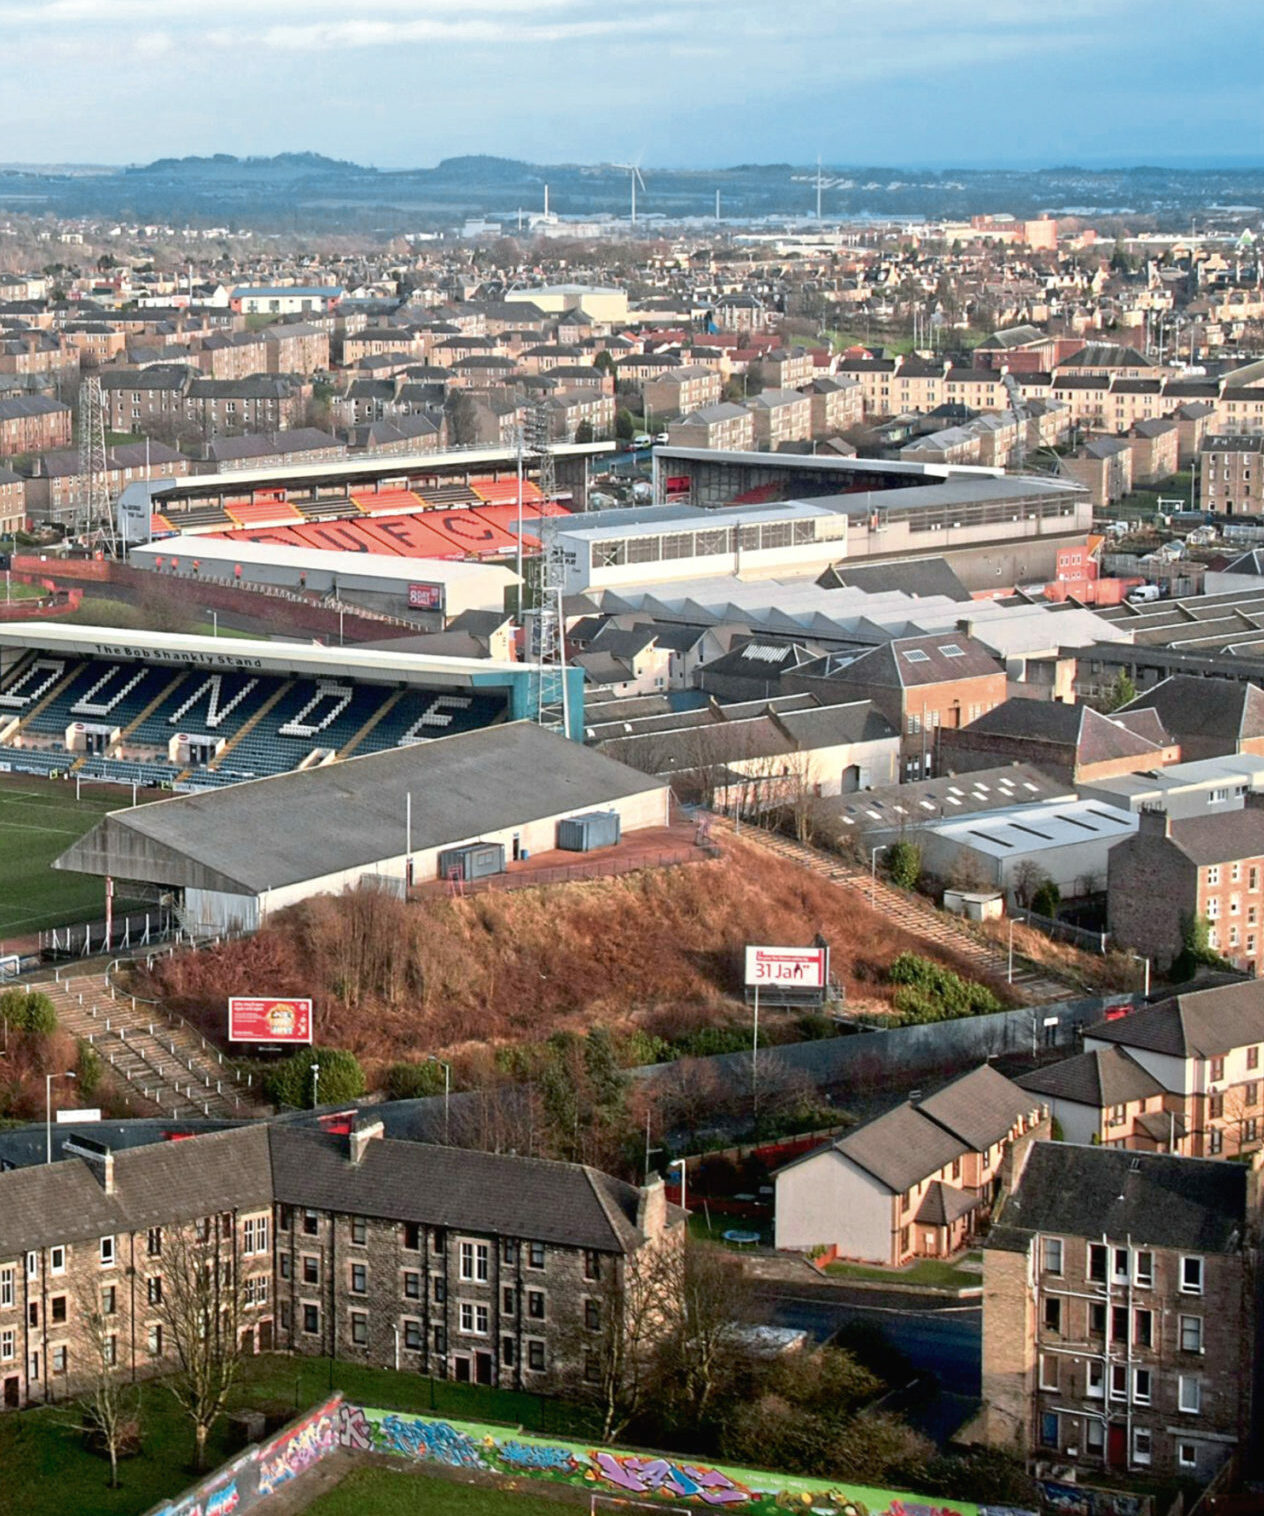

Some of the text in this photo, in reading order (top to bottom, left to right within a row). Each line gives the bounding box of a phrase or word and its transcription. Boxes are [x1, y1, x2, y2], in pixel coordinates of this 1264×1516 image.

[95, 645, 262, 668] The Bob Shankly Stand
[755, 963, 772, 979] 31
